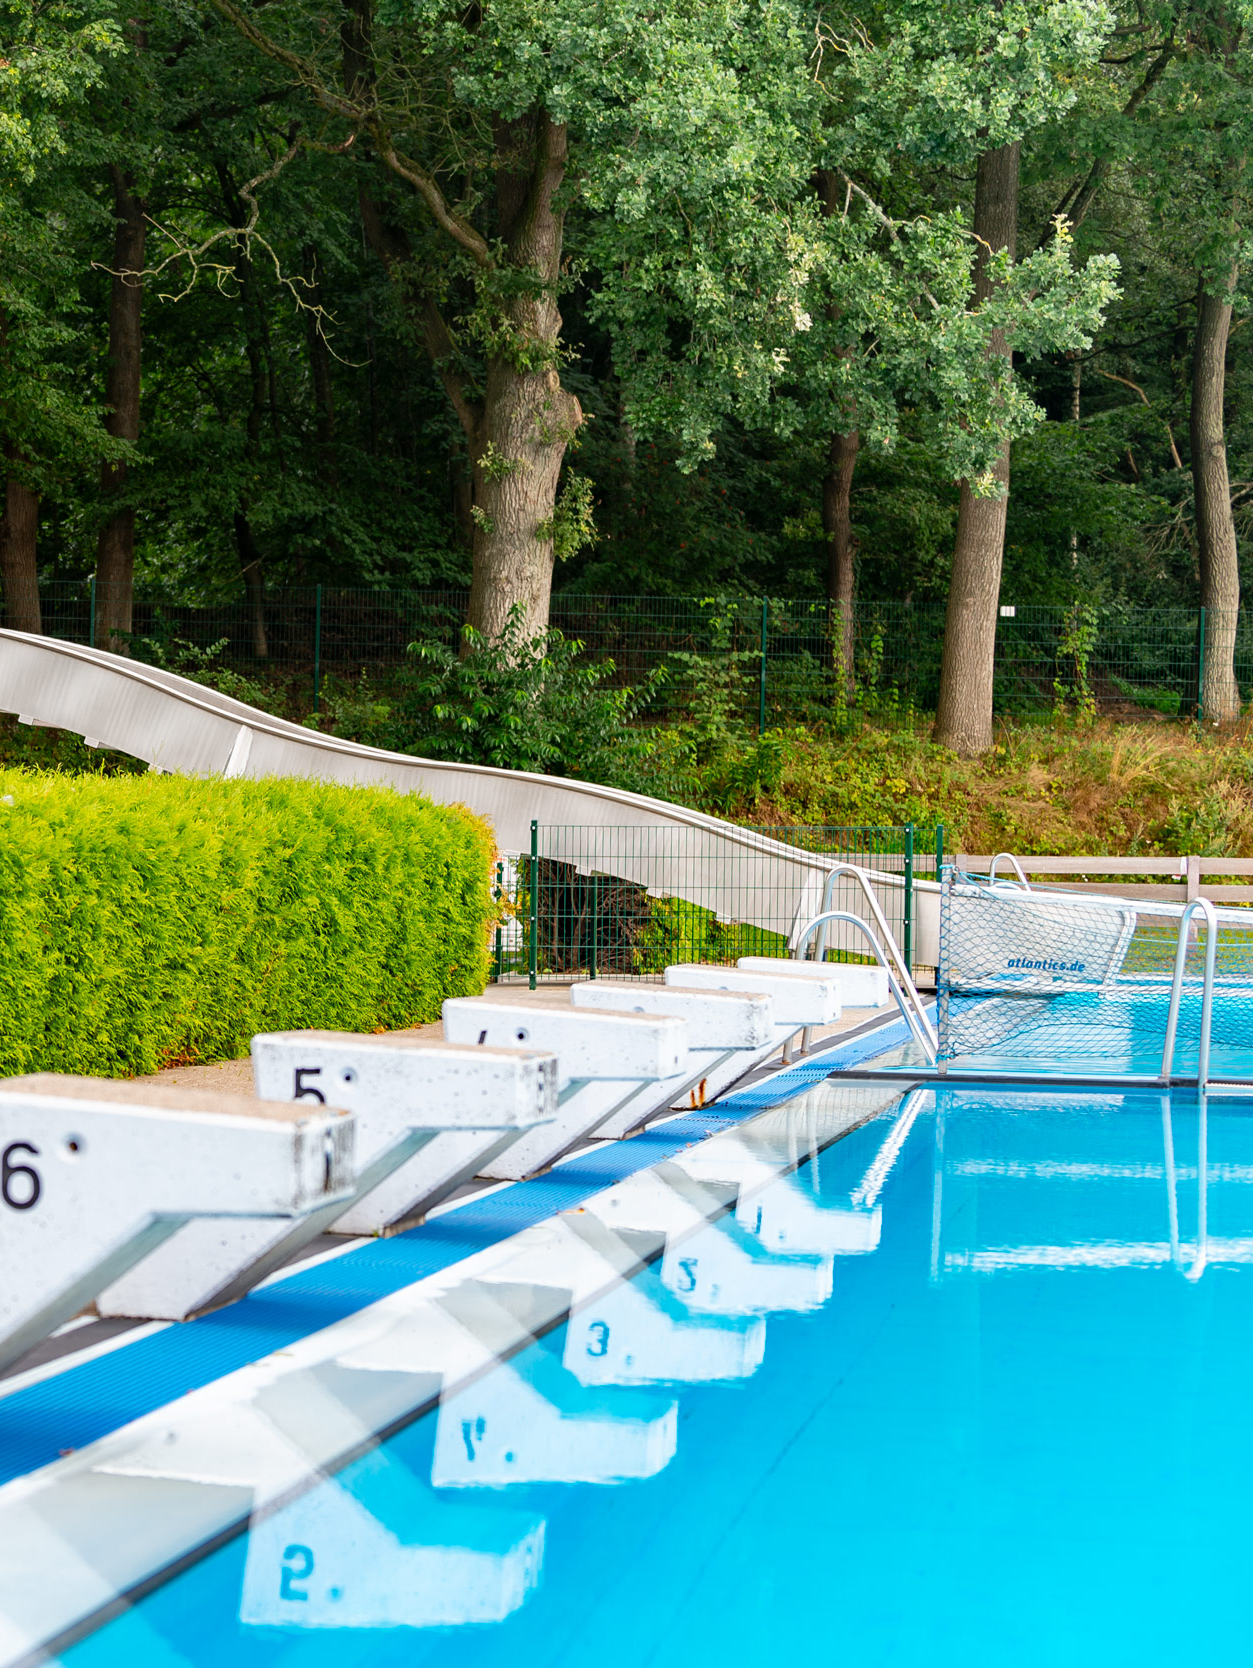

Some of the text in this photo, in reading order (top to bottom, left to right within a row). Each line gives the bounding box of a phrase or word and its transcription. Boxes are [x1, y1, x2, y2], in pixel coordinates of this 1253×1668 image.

[1007, 957, 1086, 973] atlantics.de
[294, 1067, 326, 1105] 5
[1, 1142, 41, 1210] 6
